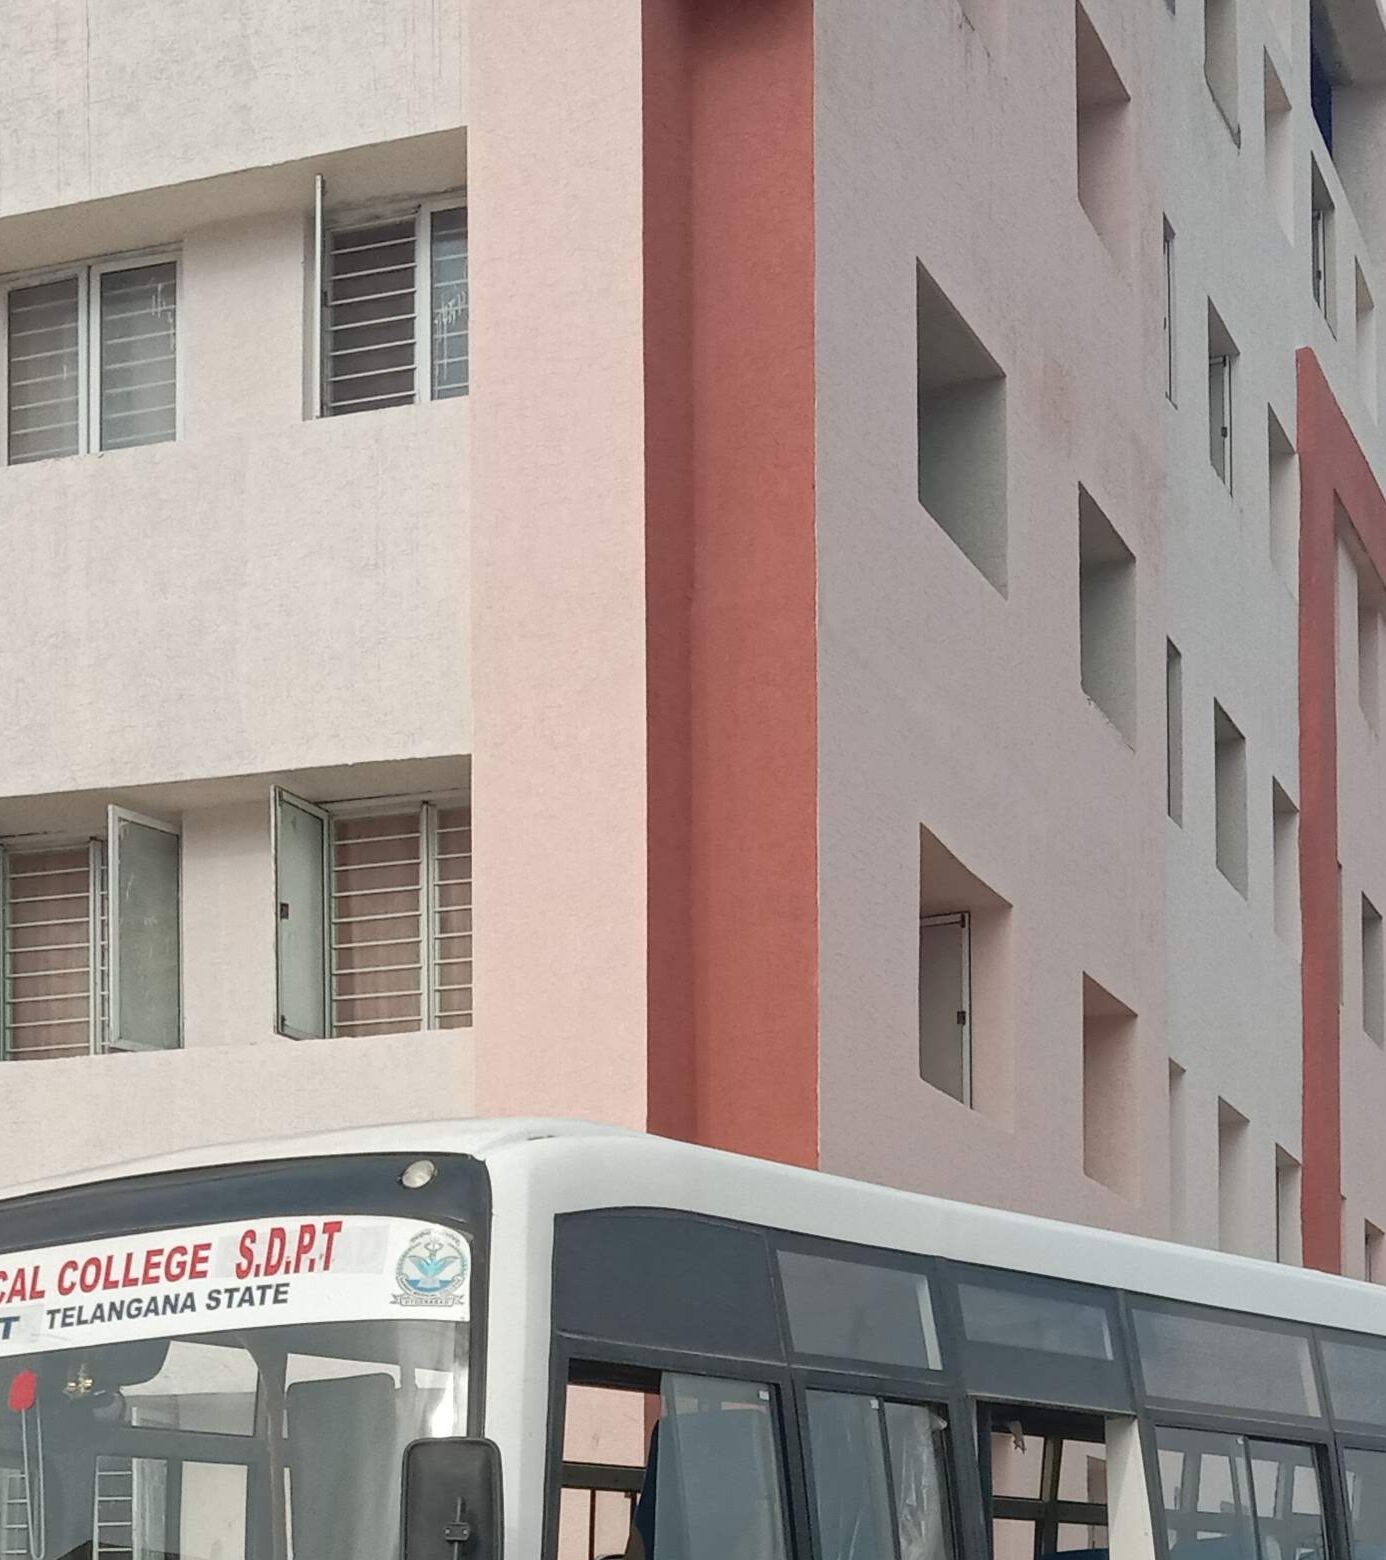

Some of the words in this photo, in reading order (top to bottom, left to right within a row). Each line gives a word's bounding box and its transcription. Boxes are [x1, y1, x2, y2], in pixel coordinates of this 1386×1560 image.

[57, 1242, 212, 1296] COLLEGE
[47, 1292, 196, 1329] TELANGANA
[206, 1283, 290, 1311] STATE
